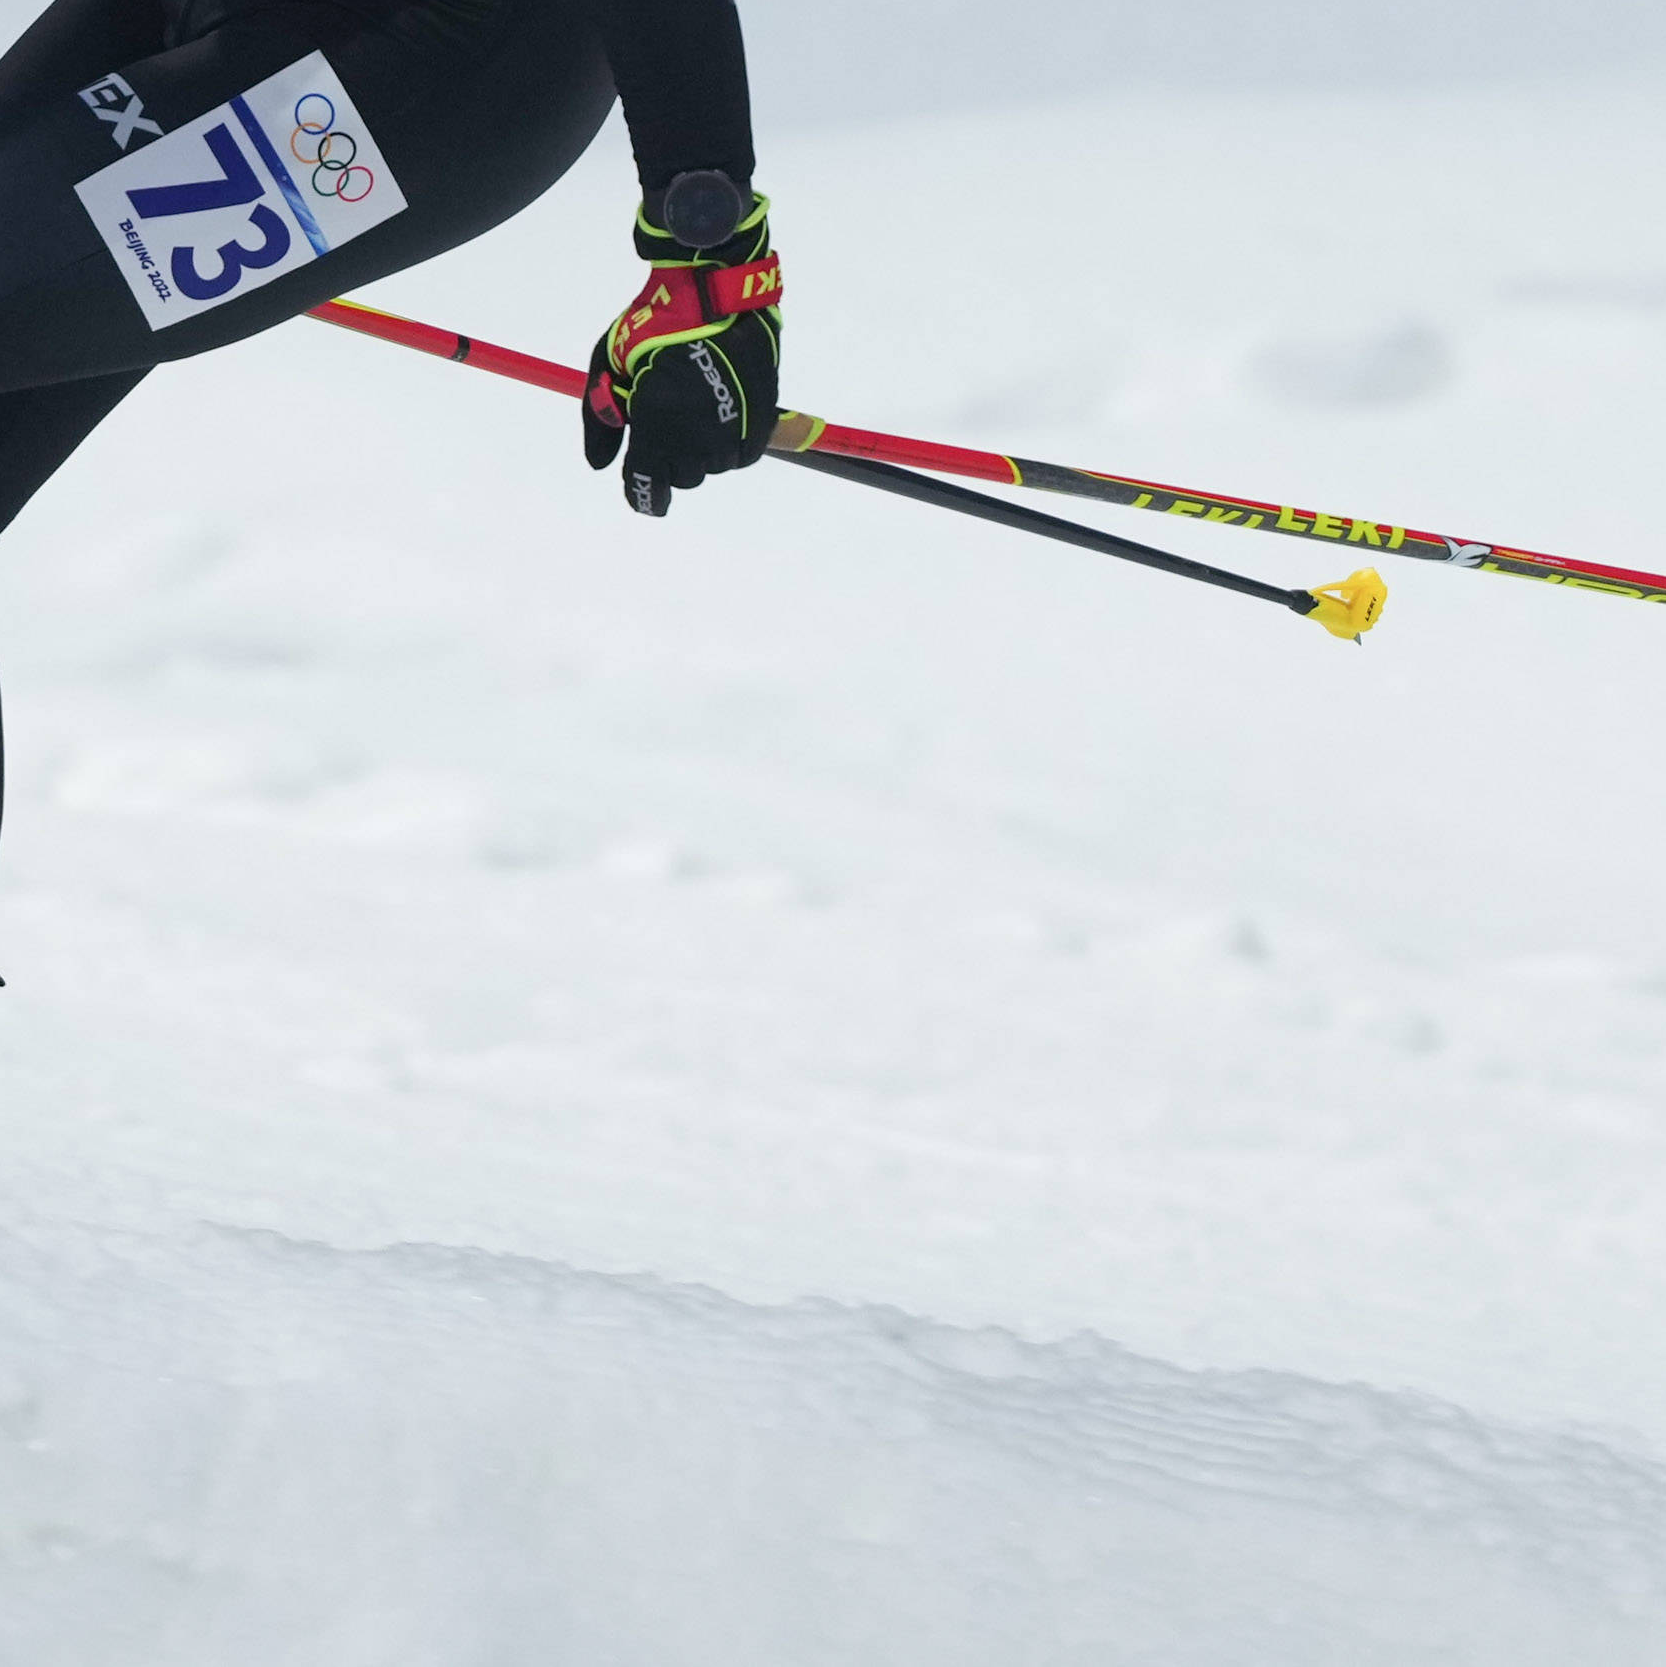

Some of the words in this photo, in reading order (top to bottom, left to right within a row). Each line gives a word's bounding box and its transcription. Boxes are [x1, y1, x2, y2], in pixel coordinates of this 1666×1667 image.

[125, 122, 292, 301] 73
[118, 217, 156, 271] BEIJING
[147, 270, 172, 304] 2022
[1275, 505, 1407, 550] LEKI
